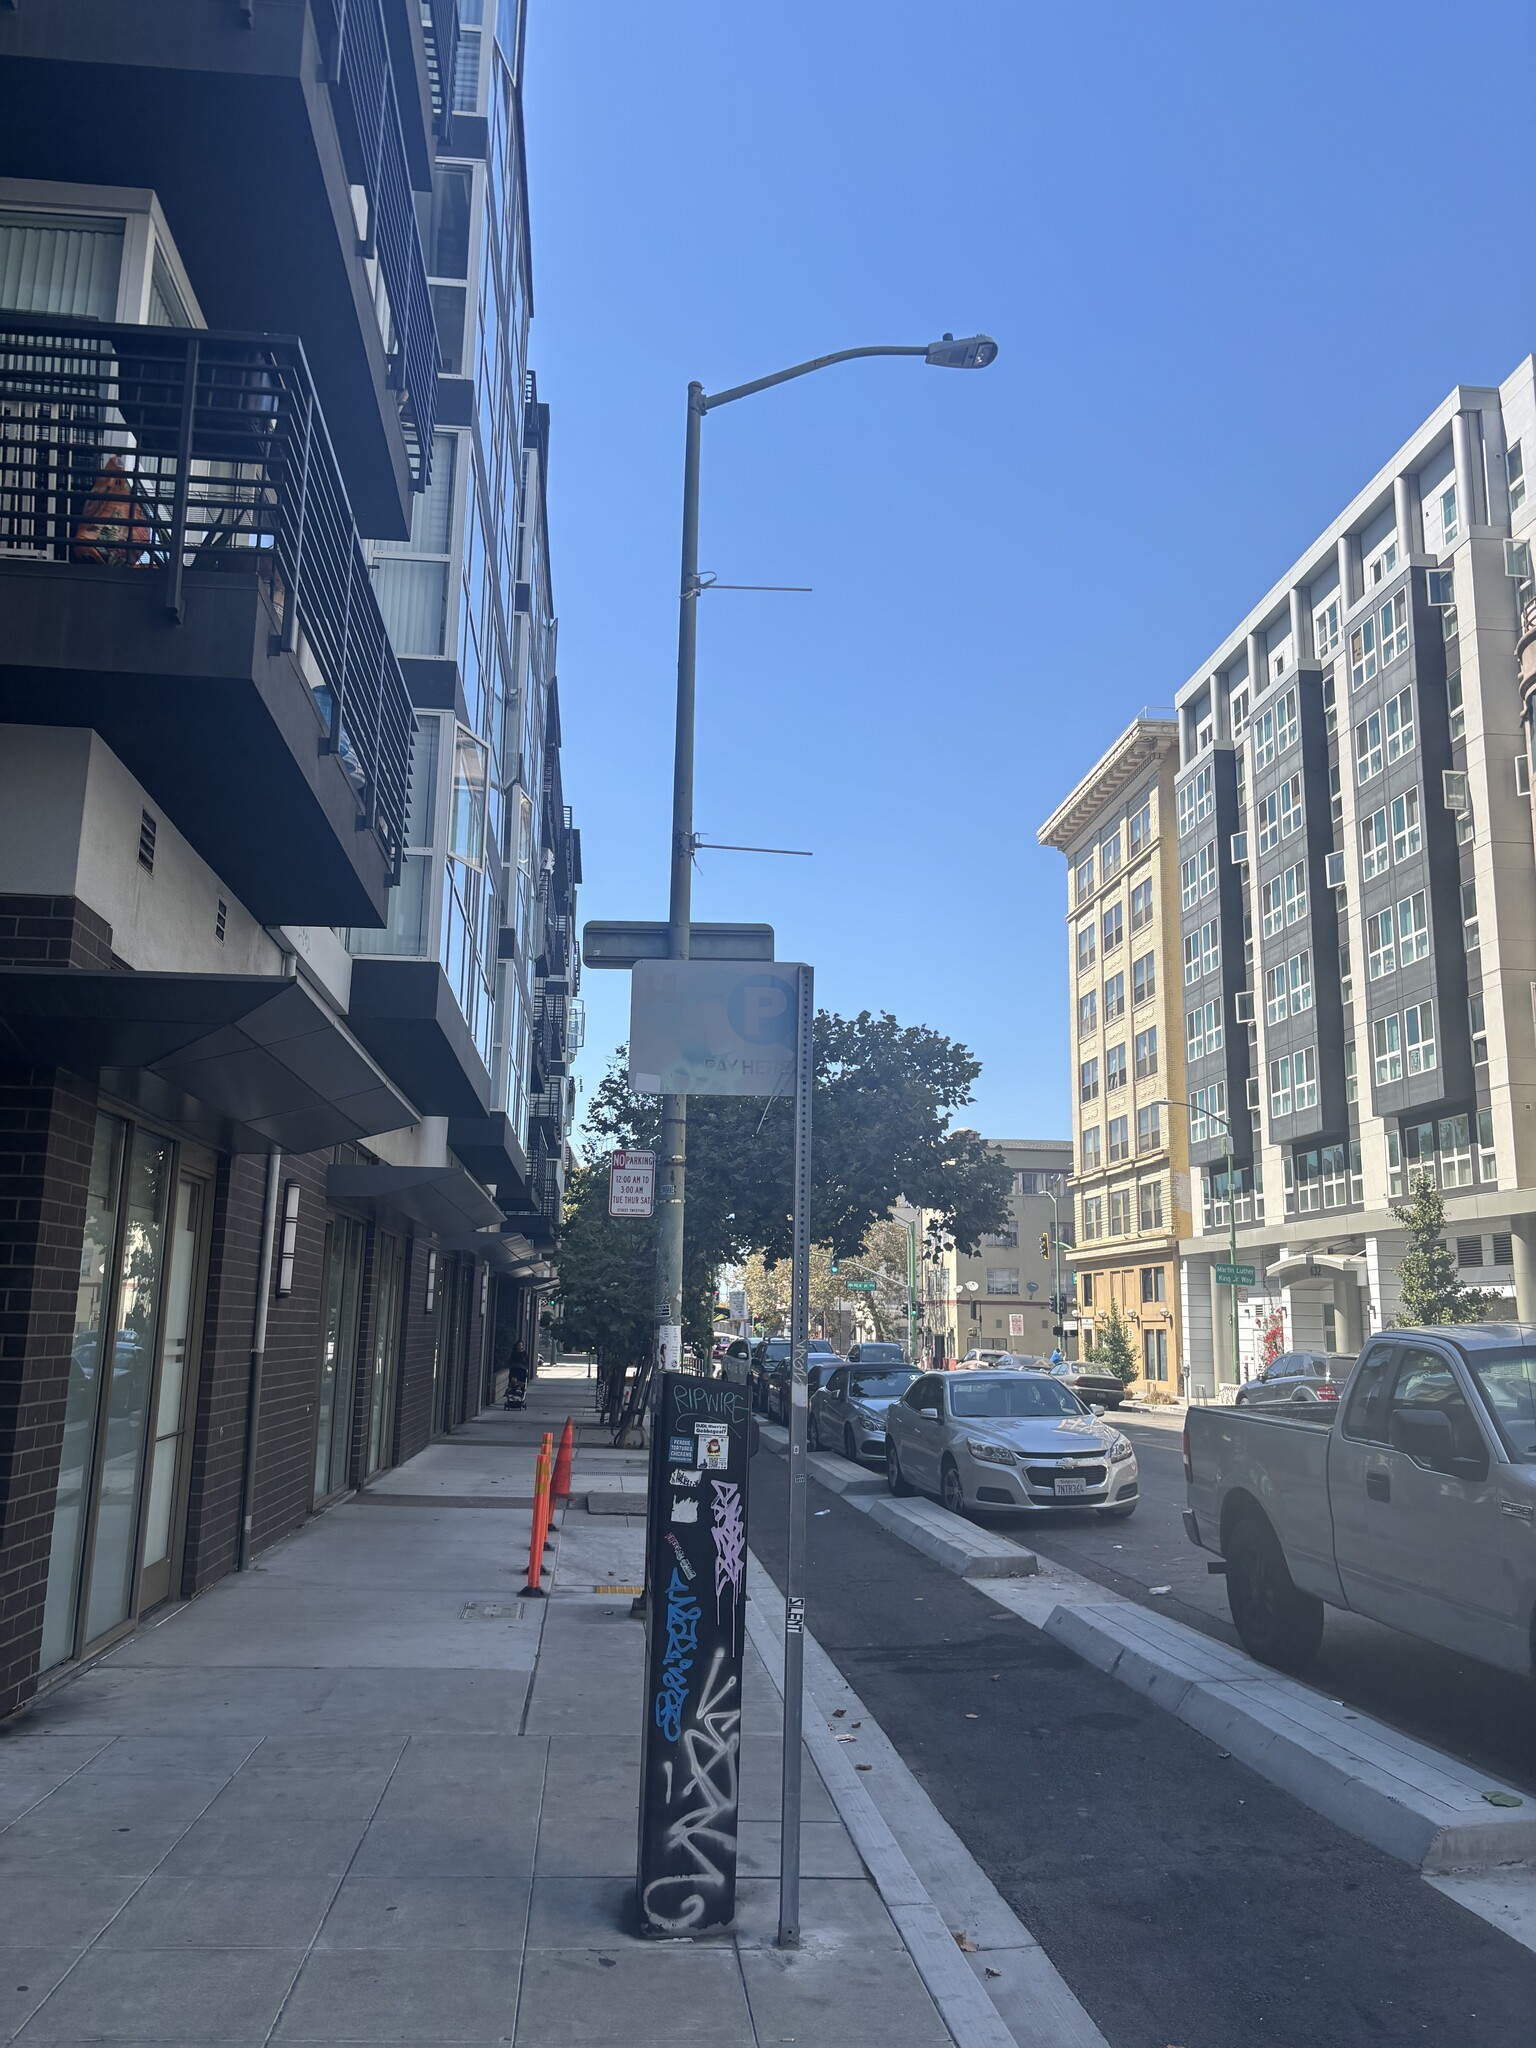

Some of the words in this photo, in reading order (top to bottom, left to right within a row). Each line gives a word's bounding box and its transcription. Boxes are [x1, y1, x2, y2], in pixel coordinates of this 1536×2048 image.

[744, 986, 788, 1036] P
[704, 1058, 738, 1073] PAY
[613, 1154, 625, 1166] NO
[625, 1156, 653, 1166] PARKING
[616, 1175, 631, 1183] 12:00
[632, 1176, 641, 1184] AM
[643, 1176, 649, 1184] TO
[620, 1186, 634, 1194] 3:00
[635, 1186, 643, 1194] AM
[613, 1195, 623, 1204] TUE
[624, 1196, 639, 1204] THUR
[640, 1196, 651, 1205] SAT
[1217, 1265, 1235, 1274] Martin
[1236, 1266, 1254, 1275] Luther
[1310, 1265, 1322, 1276] 632
[1218, 1275, 1231, 1283] King
[1241, 1276, 1253, 1284] Way
[673, 1385, 749, 1423] RIPWIRE
